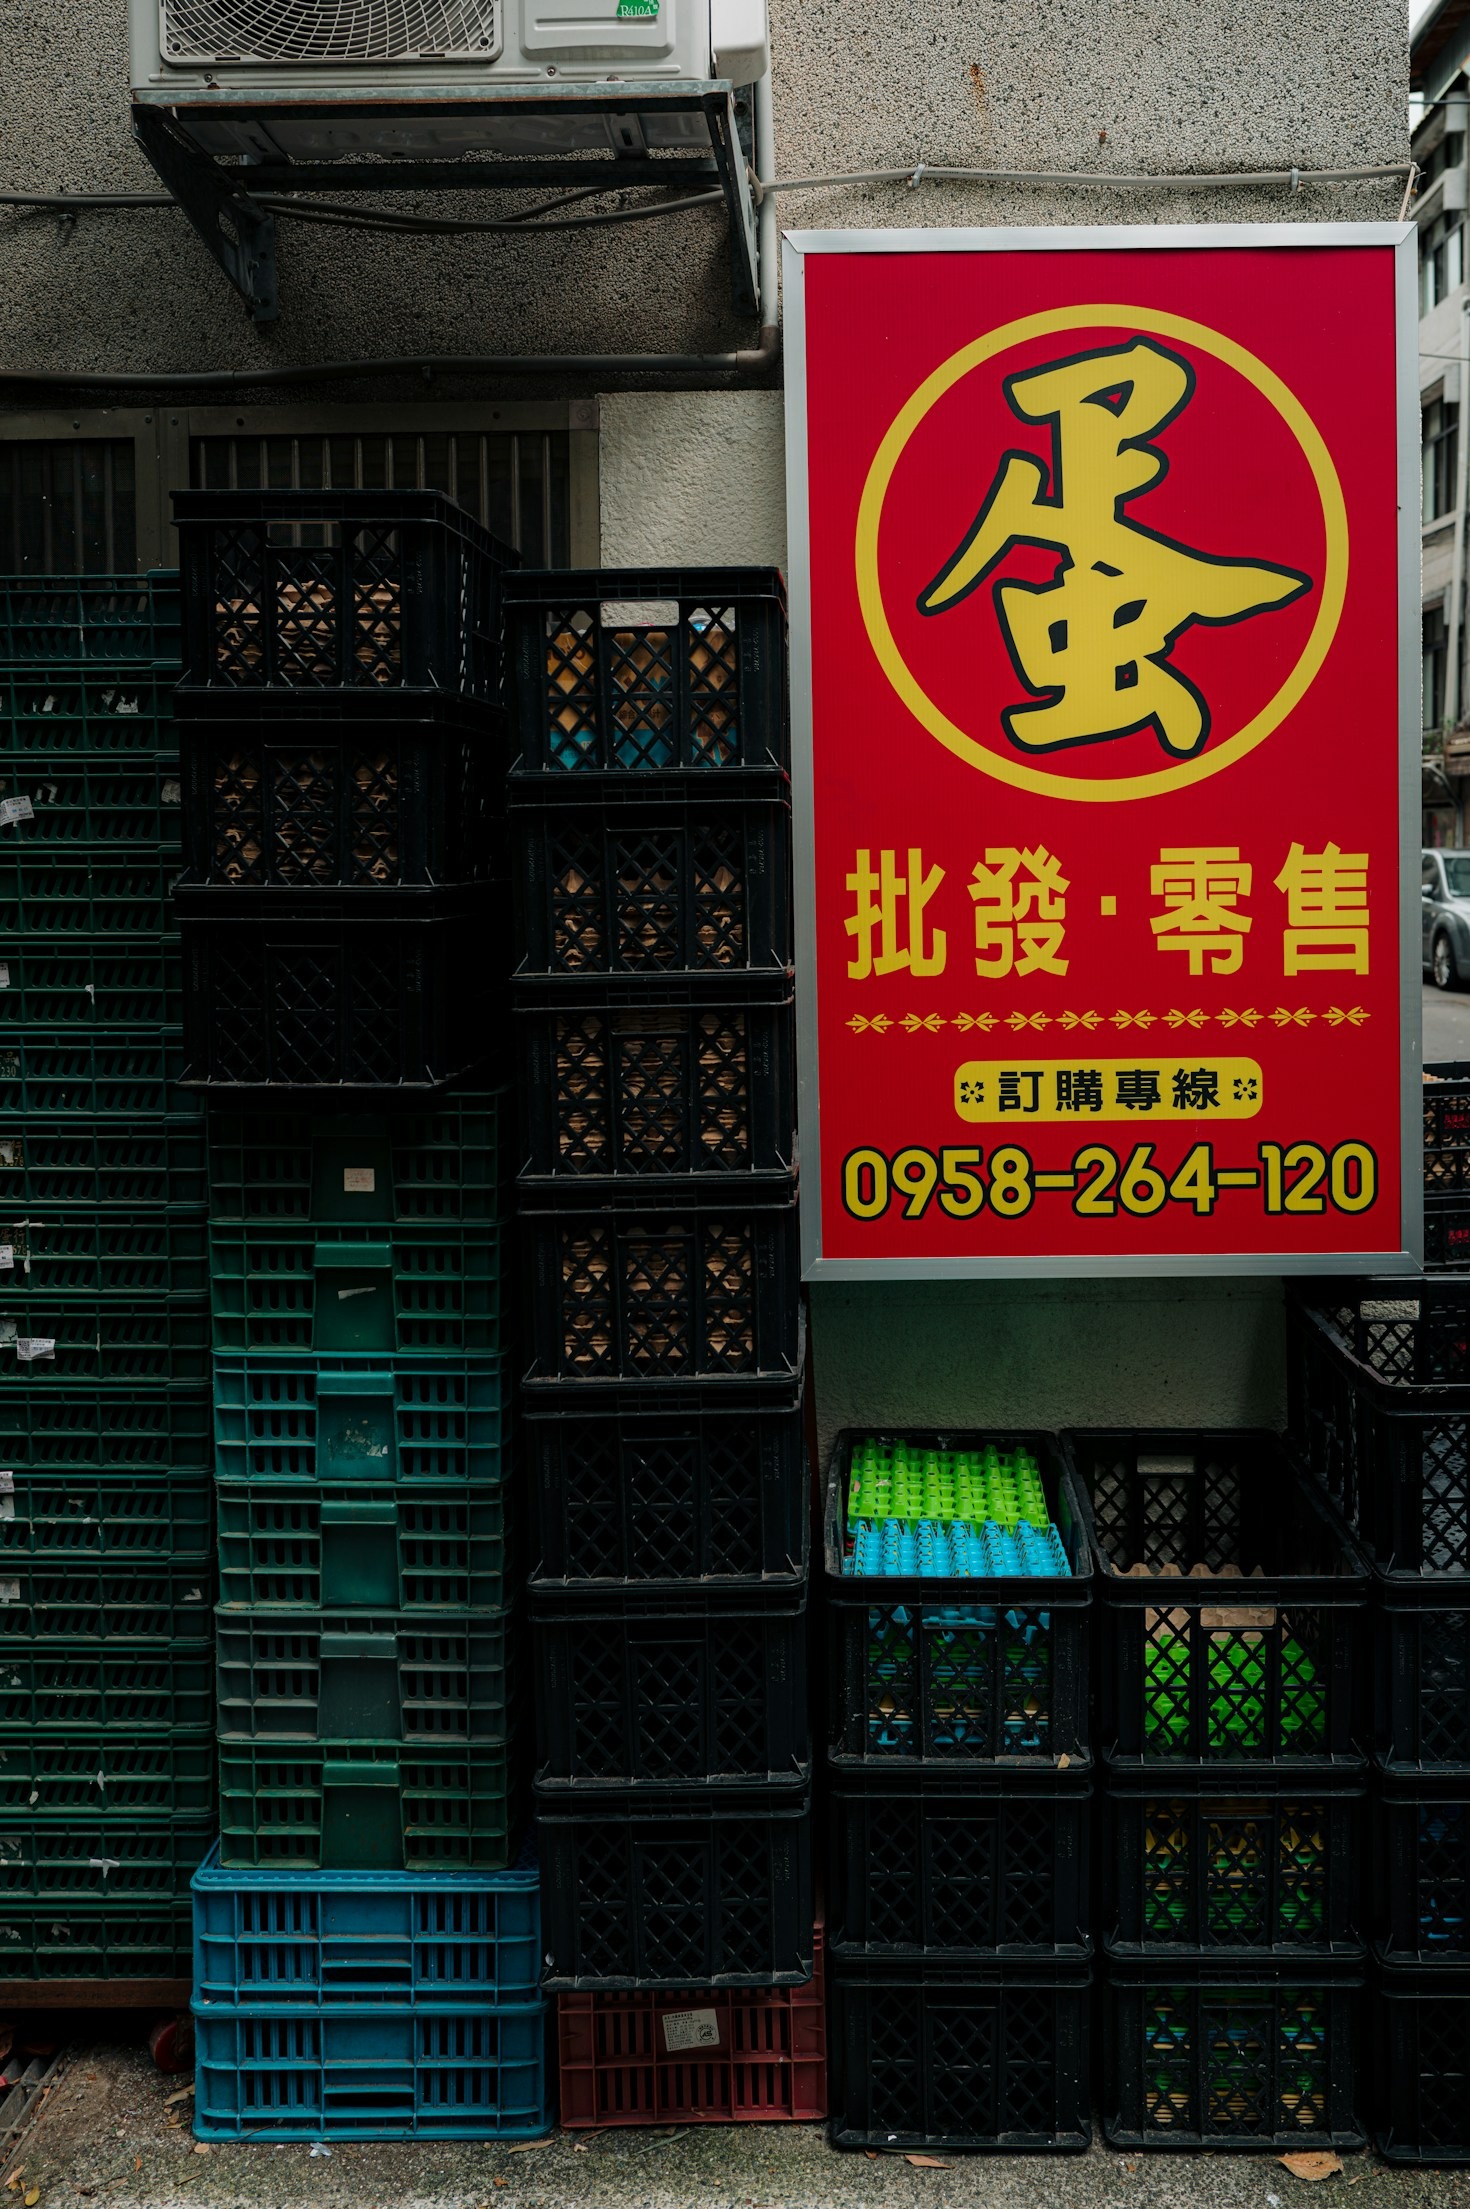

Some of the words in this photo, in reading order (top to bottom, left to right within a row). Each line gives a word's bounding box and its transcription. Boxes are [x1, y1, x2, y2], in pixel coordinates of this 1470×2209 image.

[620, 4, 652, 17] R410A
[916, 335, 1314, 760] 蛋
[998, 1068, 1220, 1113] 訂購專線
[842, 1141, 1377, 1220] 0958-264-120
